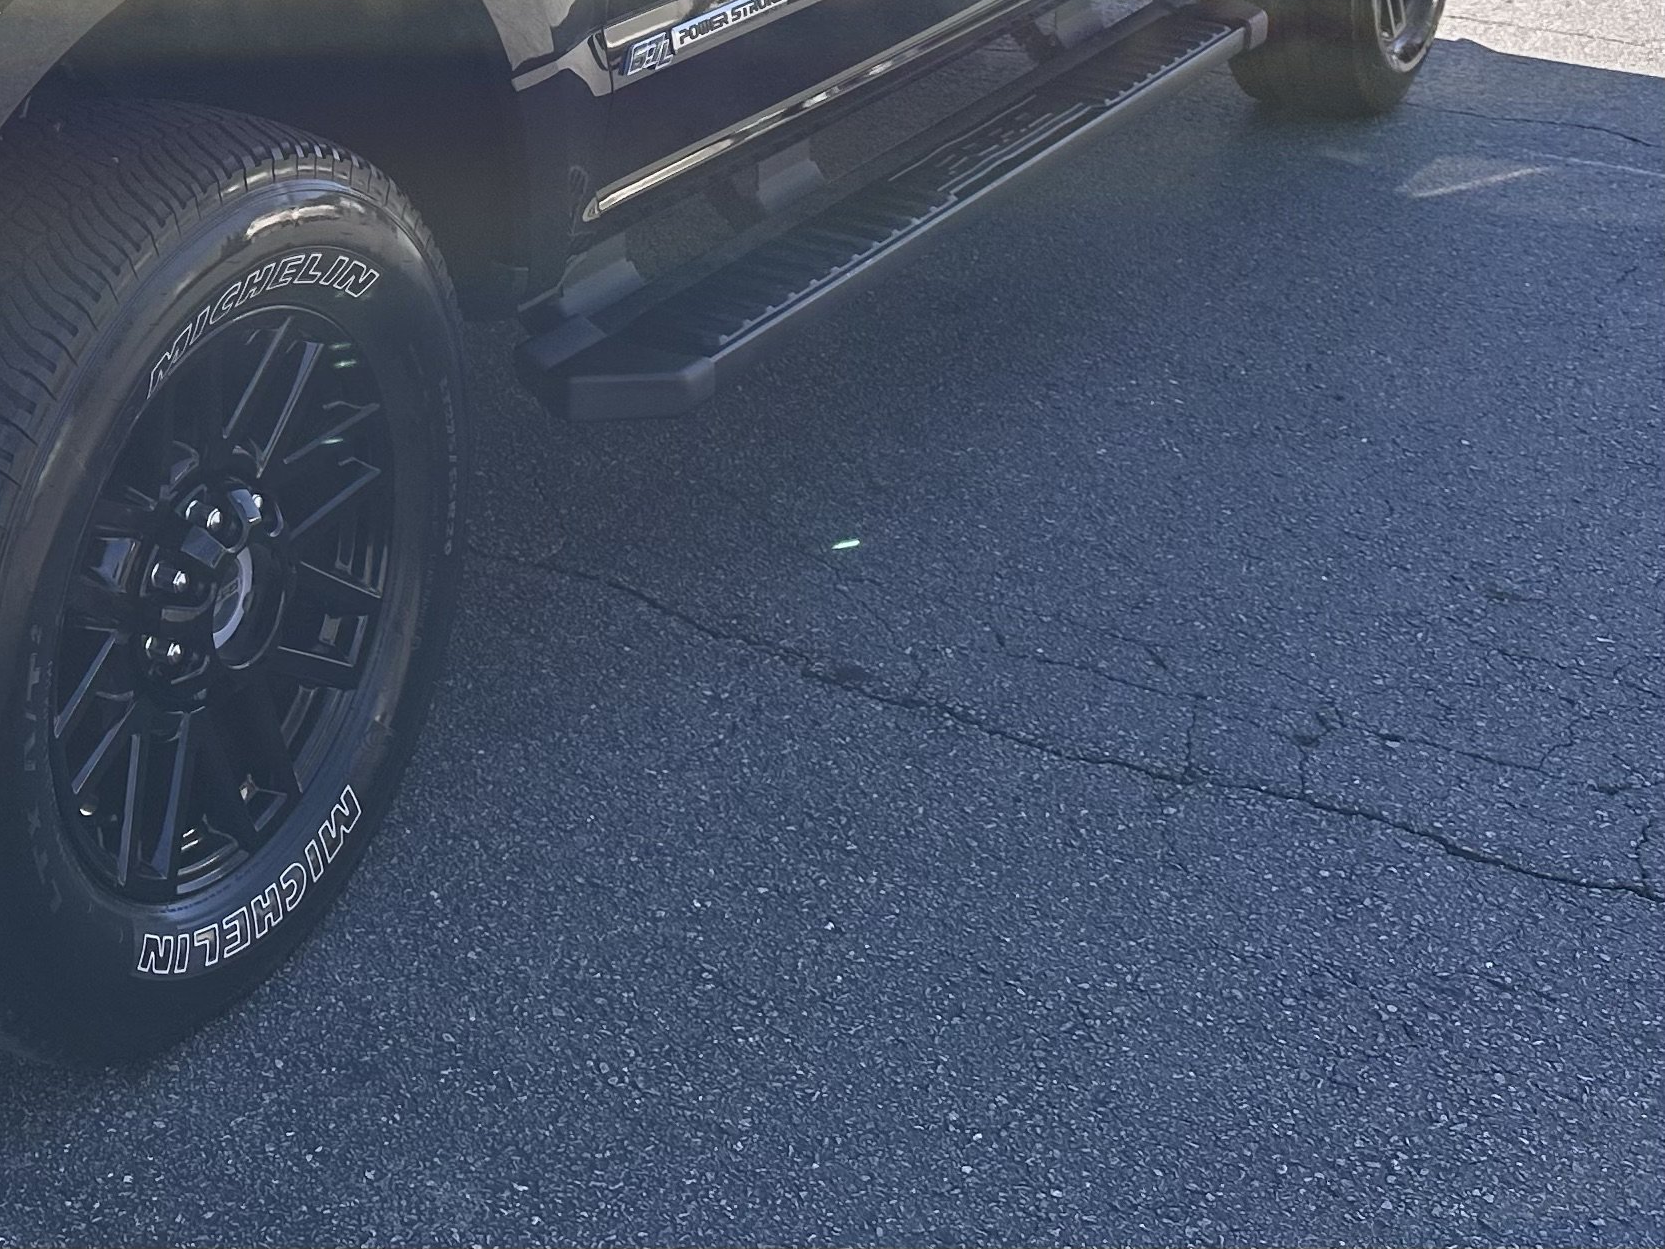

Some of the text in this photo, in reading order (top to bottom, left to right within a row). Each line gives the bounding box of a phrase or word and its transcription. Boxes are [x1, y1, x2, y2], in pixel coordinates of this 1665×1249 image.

[679, 11, 729, 45] POWER
[146, 253, 381, 400] MICHELIN
[137, 784, 362, 975] MICHELIN
